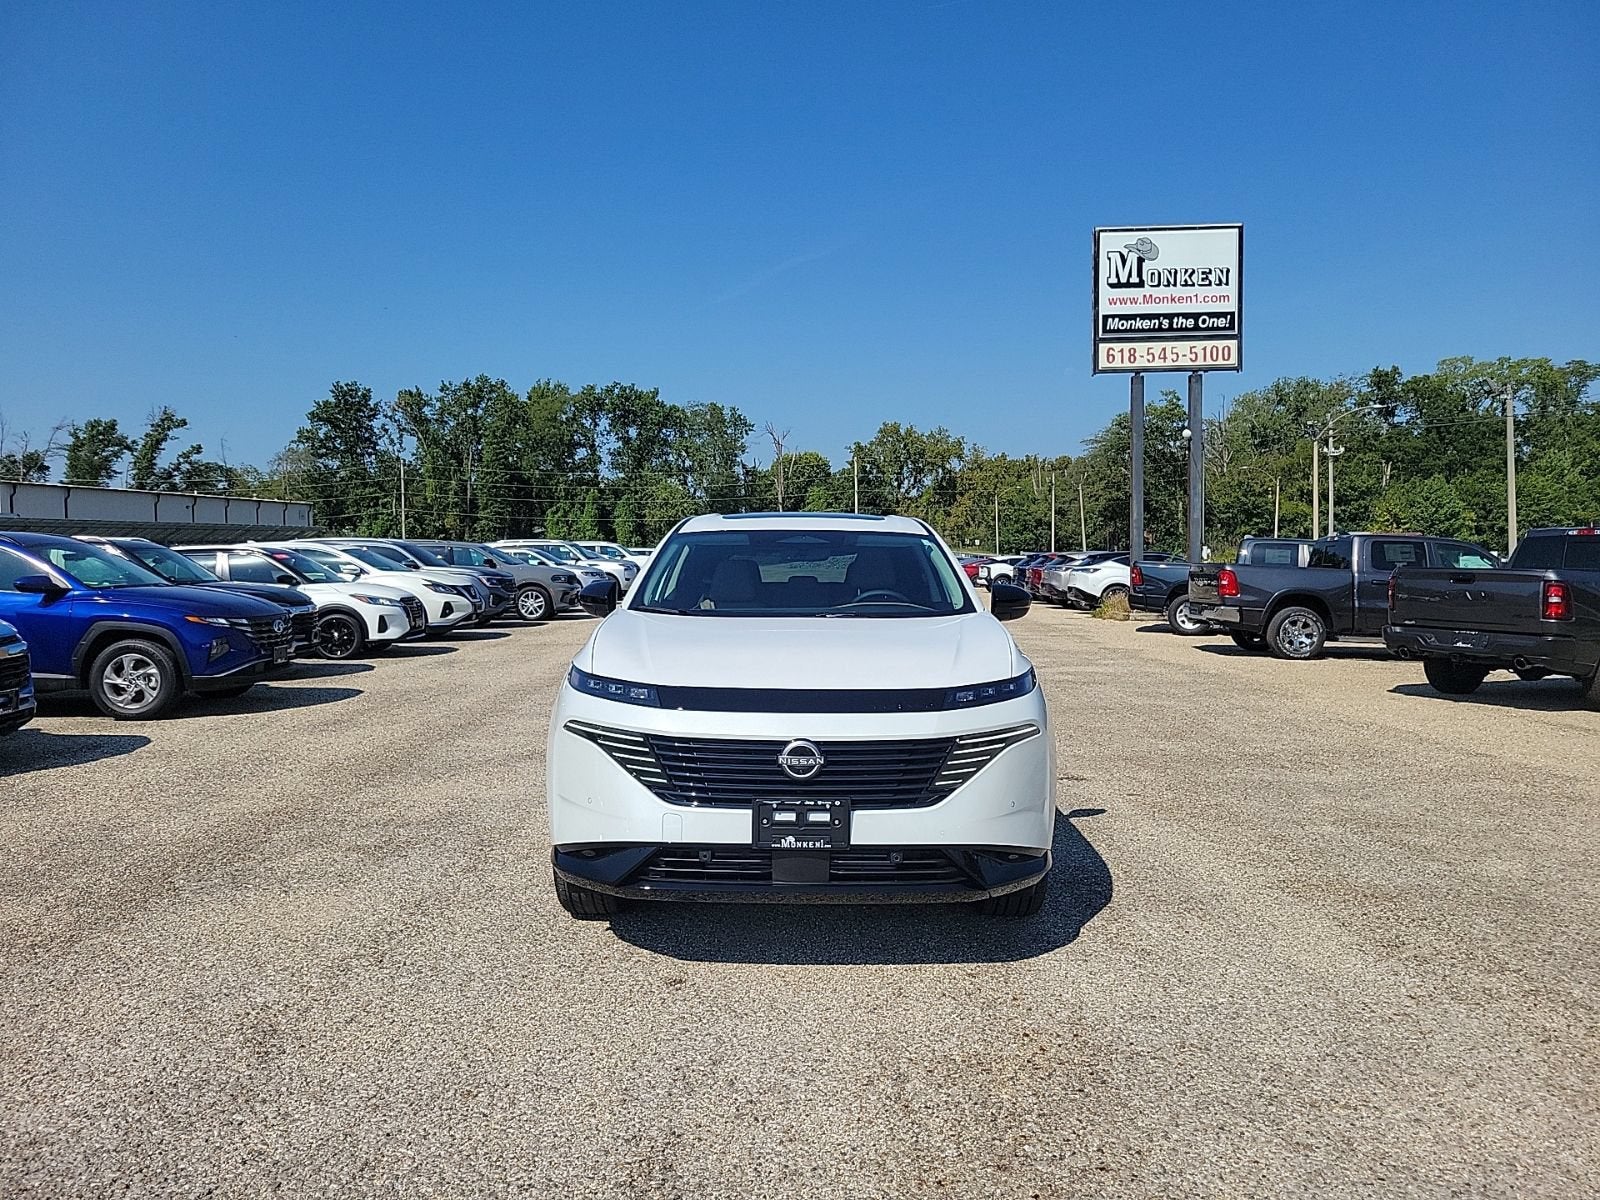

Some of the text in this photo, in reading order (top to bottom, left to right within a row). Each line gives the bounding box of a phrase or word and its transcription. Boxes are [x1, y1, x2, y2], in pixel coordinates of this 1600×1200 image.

[1107, 251, 1230, 288] MONKEN
[1108, 294, 1230, 305] www.Monken1.com
[1107, 315, 1231, 330] Monken's the One!
[1106, 345, 1231, 364] 618-545-5100
[778, 757, 824, 765] NISSAN
